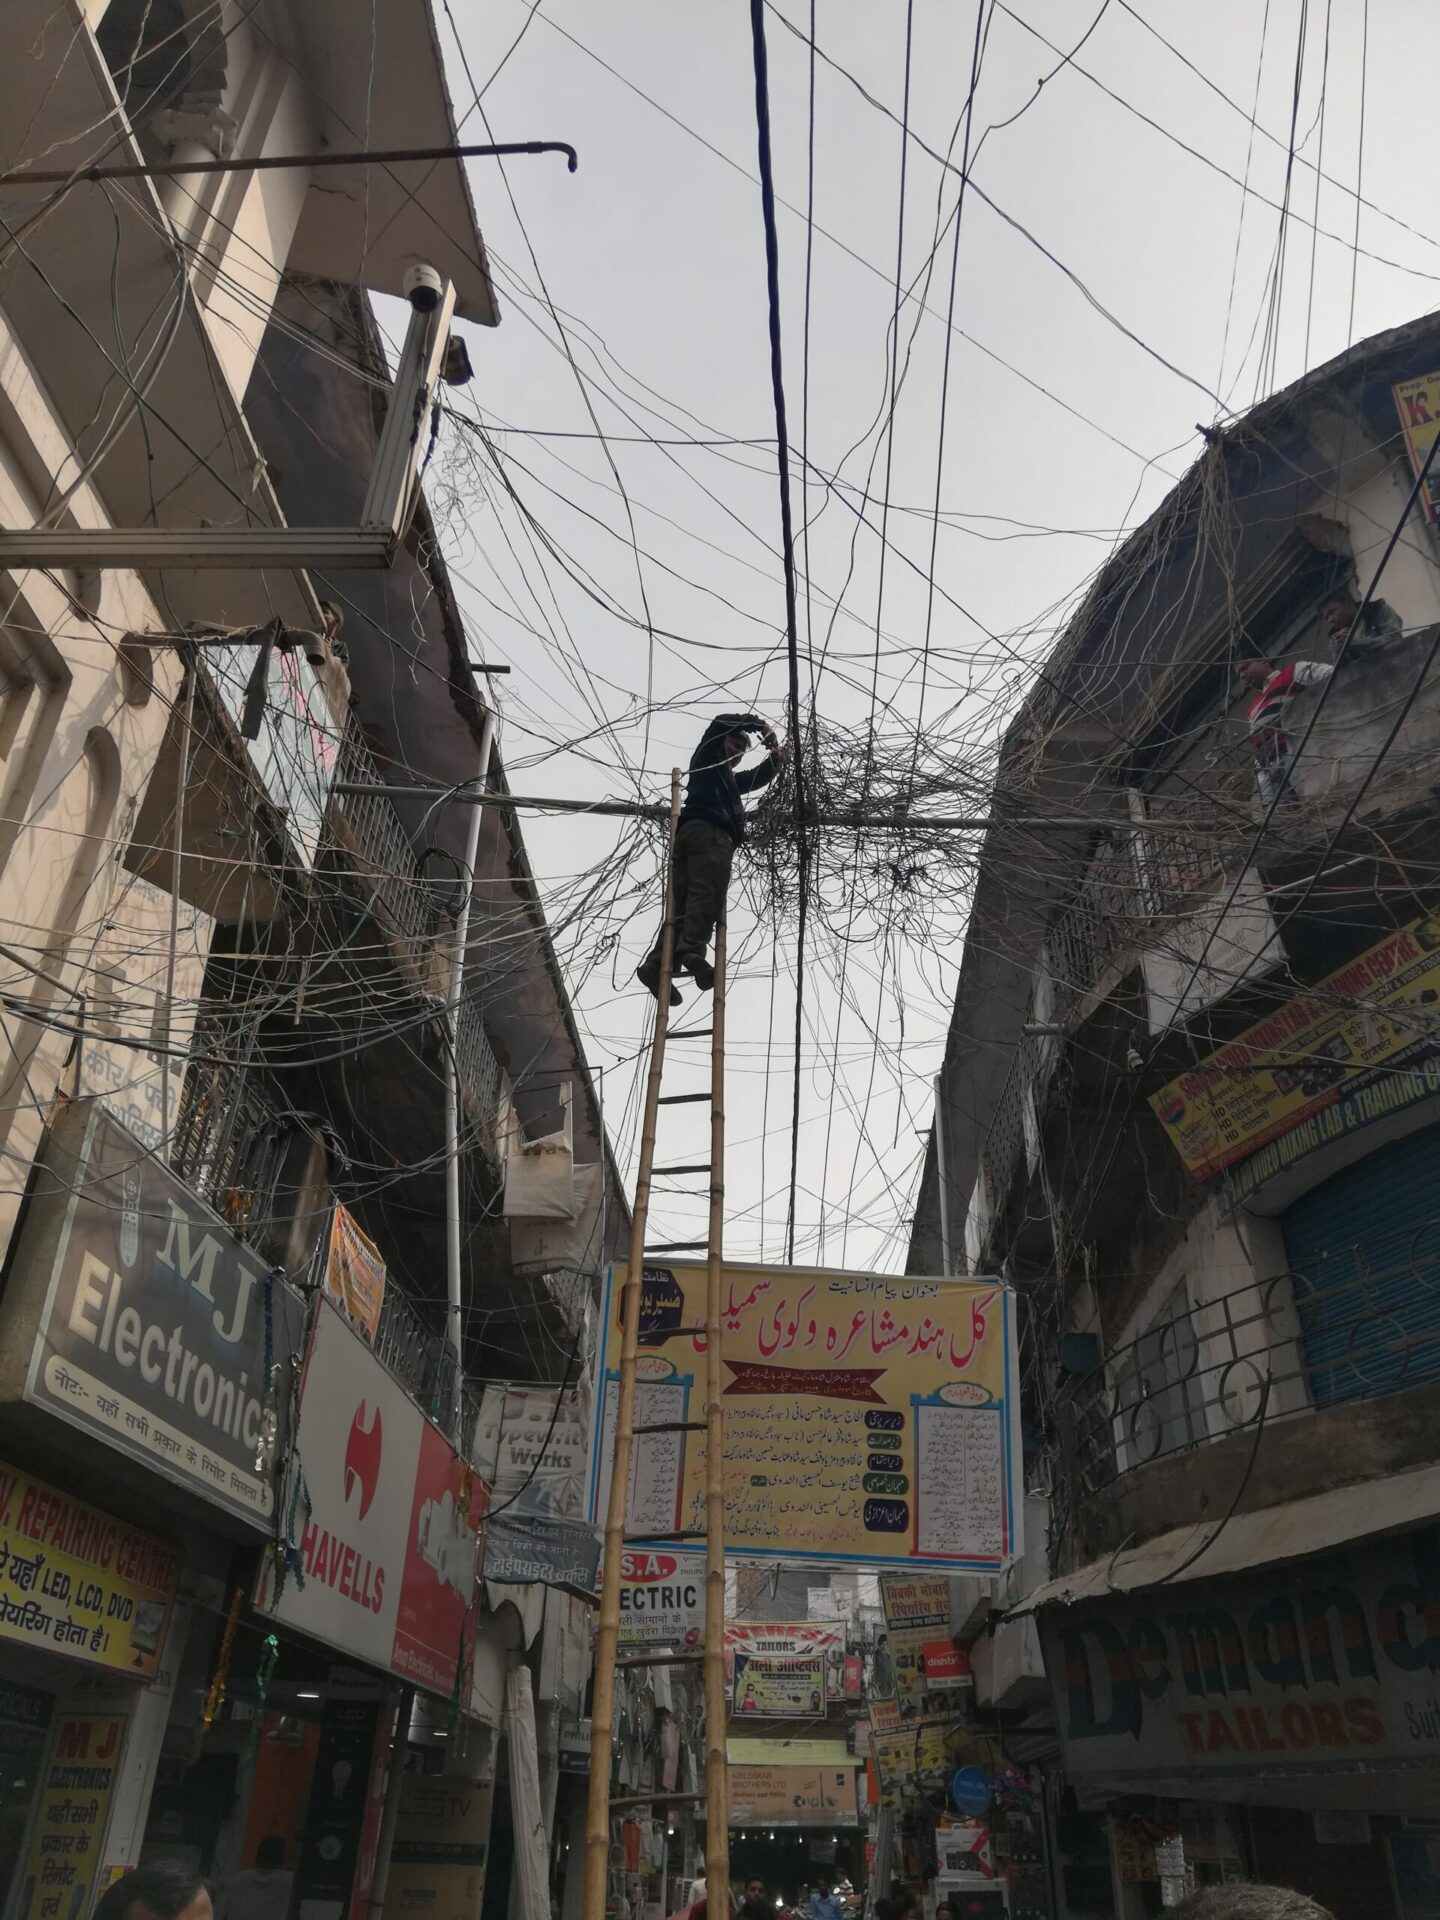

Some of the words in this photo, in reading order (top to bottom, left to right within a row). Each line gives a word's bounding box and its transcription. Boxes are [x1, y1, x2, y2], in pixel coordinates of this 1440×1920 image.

[1366, 931, 1420, 979] CENTRE
[1318, 1103, 1345, 1142] LAB
[1354, 1064, 1425, 1121] TRAINING
[1224, 1130, 1239, 1143] HD
[826, 1308, 910, 1361] مشاعرہ
[906, 1317, 945, 1361] ہند
[950, 1290, 997, 1368] کل
[96, 1391, 120, 1422] यहाँ
[124, 1407, 150, 1441] सभी
[153, 1427, 182, 1458] प्रकार
[185, 1444, 198, 1467] के
[200, 1452, 227, 1486] रिमोट
[230, 1471, 259, 1501] मिलता
[510, 1447, 573, 1469] Works
[16, 1483, 115, 1569] REPAIRING
[116, 1530, 178, 1595] CENTRE
[9, 1552, 47, 1592] यहाँ
[41, 1567, 72, 1609] LED,
[76, 1579, 104, 1619] LCD,
[107, 1592, 134, 1623] DVD
[302, 1522, 384, 1615] HAVELLS
[621, 1555, 669, 1578] S.A.
[619, 1585, 697, 1611] ECTRIC
[671, 1612, 682, 1625] के
[53, 1614, 90, 1646] होता
[755, 1641, 797, 1652] TAILORS
[564, 1730, 592, 1741] PHILI
[1177, 1695, 1386, 1752] TAILORS
[74, 1830, 93, 1853] के
